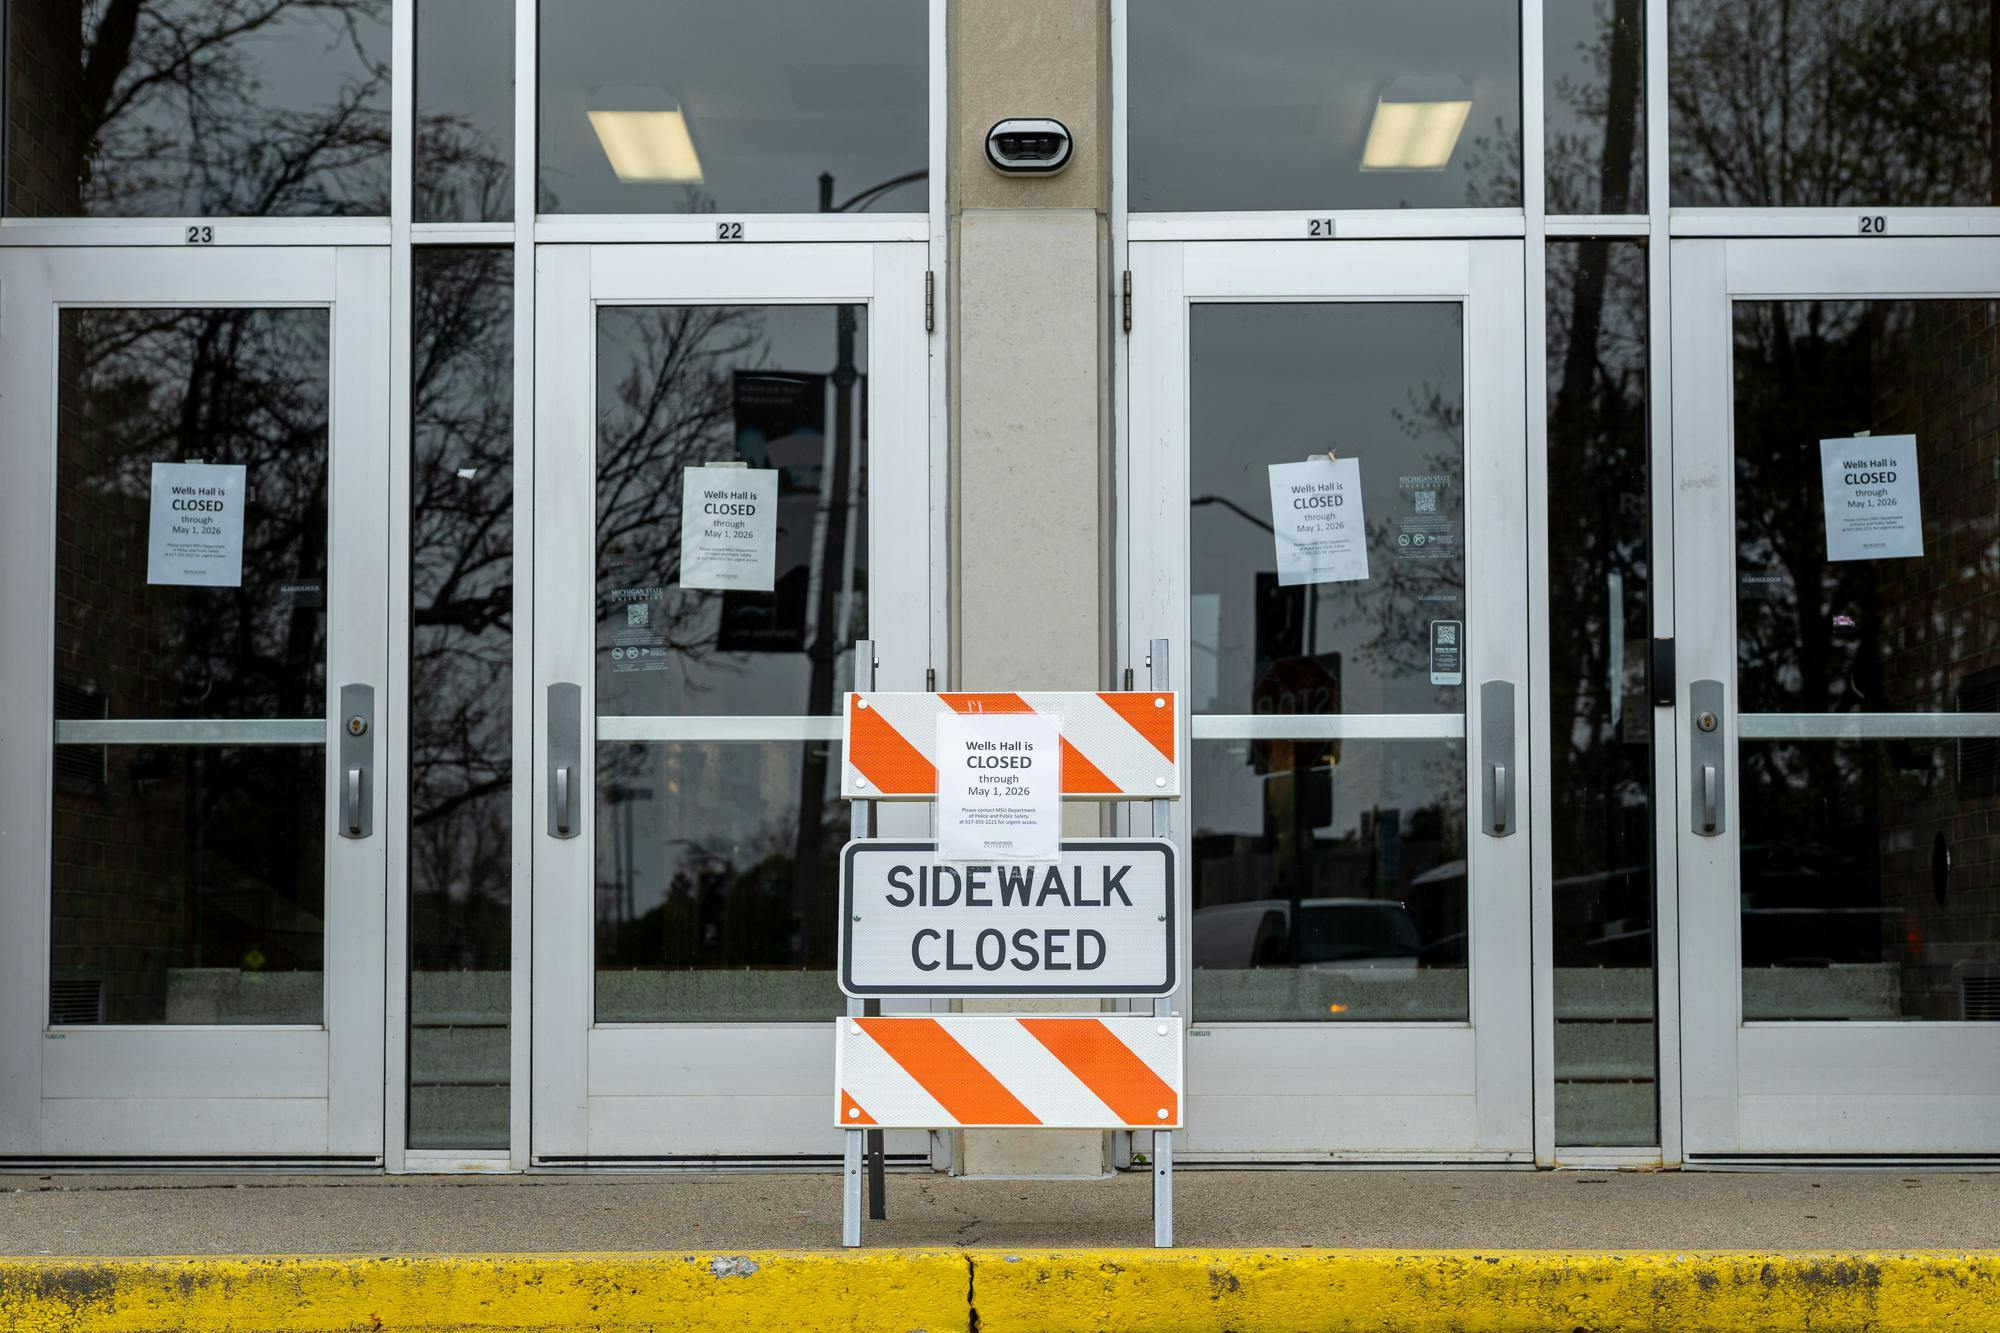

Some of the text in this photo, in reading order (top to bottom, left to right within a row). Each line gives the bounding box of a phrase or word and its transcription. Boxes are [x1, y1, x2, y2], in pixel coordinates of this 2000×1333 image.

[1310, 219, 1331, 235] 21
[1861, 216, 1885, 233] 20
[189, 226, 211, 242] 23
[719, 222, 741, 239] 22
[1843, 458, 1897, 469] Wells Hall is
[1845, 471, 1897, 485] CLOSED
[172, 486, 225, 496] Wells Hall is
[1291, 482, 1343, 494] Wells Hall is
[1855, 488, 1888, 498] through
[704, 490, 757, 500] Wells Hall is
[172, 499, 223, 511] CLOSED
[1293, 495, 1343, 510] CLOSED
[1847, 498, 1897, 509] May 1, 2026
[704, 503, 756, 515] CLOSED
[181, 516, 213, 525] through
[1304, 512, 1336, 522] through
[713, 519, 745, 529] through
[1296, 522, 1344, 533] May 1, 2026
[172, 526, 190, 535] May
[192, 526, 199, 535] 1,
[704, 530, 754, 539] May 1, 2026
[966, 741, 1033, 751] Wells Hall is
[967, 756, 1032, 769] CLOSED
[979, 774, 1019, 785] through
[968, 787, 1030, 797] May 1, 2026
[886, 865, 1133, 908] SIDEWALK
[911, 928, 1107, 971] CLOSED
